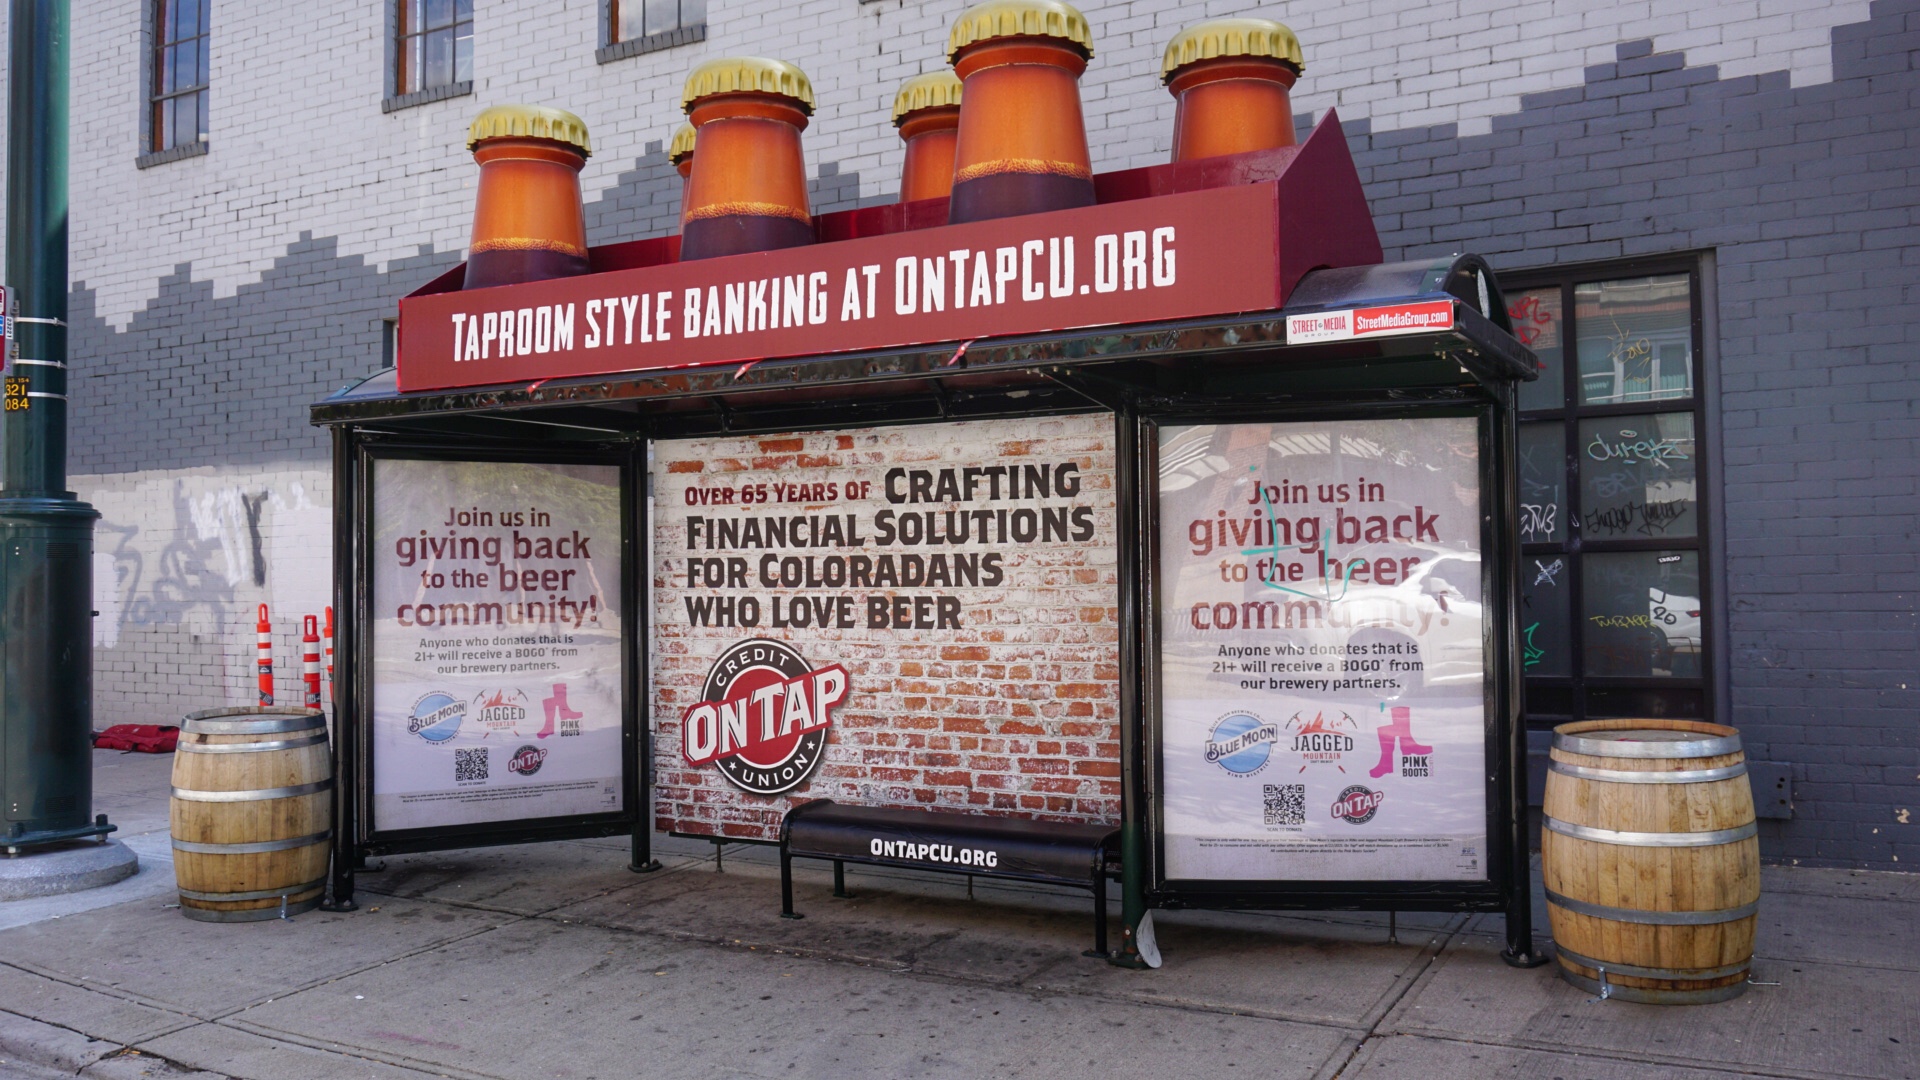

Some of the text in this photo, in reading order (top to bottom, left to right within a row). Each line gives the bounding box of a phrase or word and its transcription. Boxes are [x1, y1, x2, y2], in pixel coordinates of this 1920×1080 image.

[452, 226, 1176, 362] TAPROOM STYLE BANKING AT ONTAPCU.ORG
[1292, 316, 1347, 334] STREET MEDIA
[1356, 311, 1448, 330] StreetMediaGroup.com
[5, 383, 26, 396] 321
[5, 397, 30, 411] 084
[684, 462, 1082, 506] OVER 65 YEARS OF CRAFTING
[1248, 477, 1385, 504] Join us in
[444, 507, 551, 527] Join us in
[686, 506, 1095, 550] FINANCIAL SOLUTIONS
[1189, 506, 1440, 556] giving back
[396, 530, 591, 567] giving back
[421, 563, 577, 592] to the beer
[686, 553, 1004, 588] FOR COLORADANS
[1219, 550, 1421, 586] to the beer
[397, 594, 597, 629] community!
[683, 596, 962, 629] WHO LOVE BEER
[419, 634, 574, 650] Anyone who donates that is
[1218, 642, 1418, 662] Anyone who donates that is
[414, 651, 435, 662] 21+
[438, 650, 459, 661] will
[462, 649, 503, 660] receive
[505, 650, 512, 659] a
[551, 646, 578, 657] from
[437, 661, 561, 674] our brewery partners.
[716, 648, 789, 687] CREDIT
[1212, 661, 1237, 673] 21+
[1241, 660, 1267, 673] will
[1271, 660, 1322, 673] receive
[1327, 663, 1335, 672] a
[1389, 659, 1424, 671] from
[1240, 677, 1401, 691] our brewery partners.
[409, 703, 465, 733] BLUE MOON
[477, 707, 525, 722] JAGGED
[560, 720, 580, 729] PINK
[685, 668, 846, 762] ON TAP
[560, 729, 580, 737] BOOTS
[1206, 727, 1275, 761] BLUE MOON
[1291, 734, 1353, 752] JAGGED
[509, 758, 525, 772] ON
[525, 749, 547, 766] TAP
[1303, 752, 1341, 760] MOUNTAIN
[1402, 756, 1428, 767] PINK
[742, 753, 809, 787] UNION
[1402, 768, 1429, 777] BOOTS
[1332, 792, 1383, 818] ON TAP
[870, 838, 998, 867] ONTAPCU.ORG
